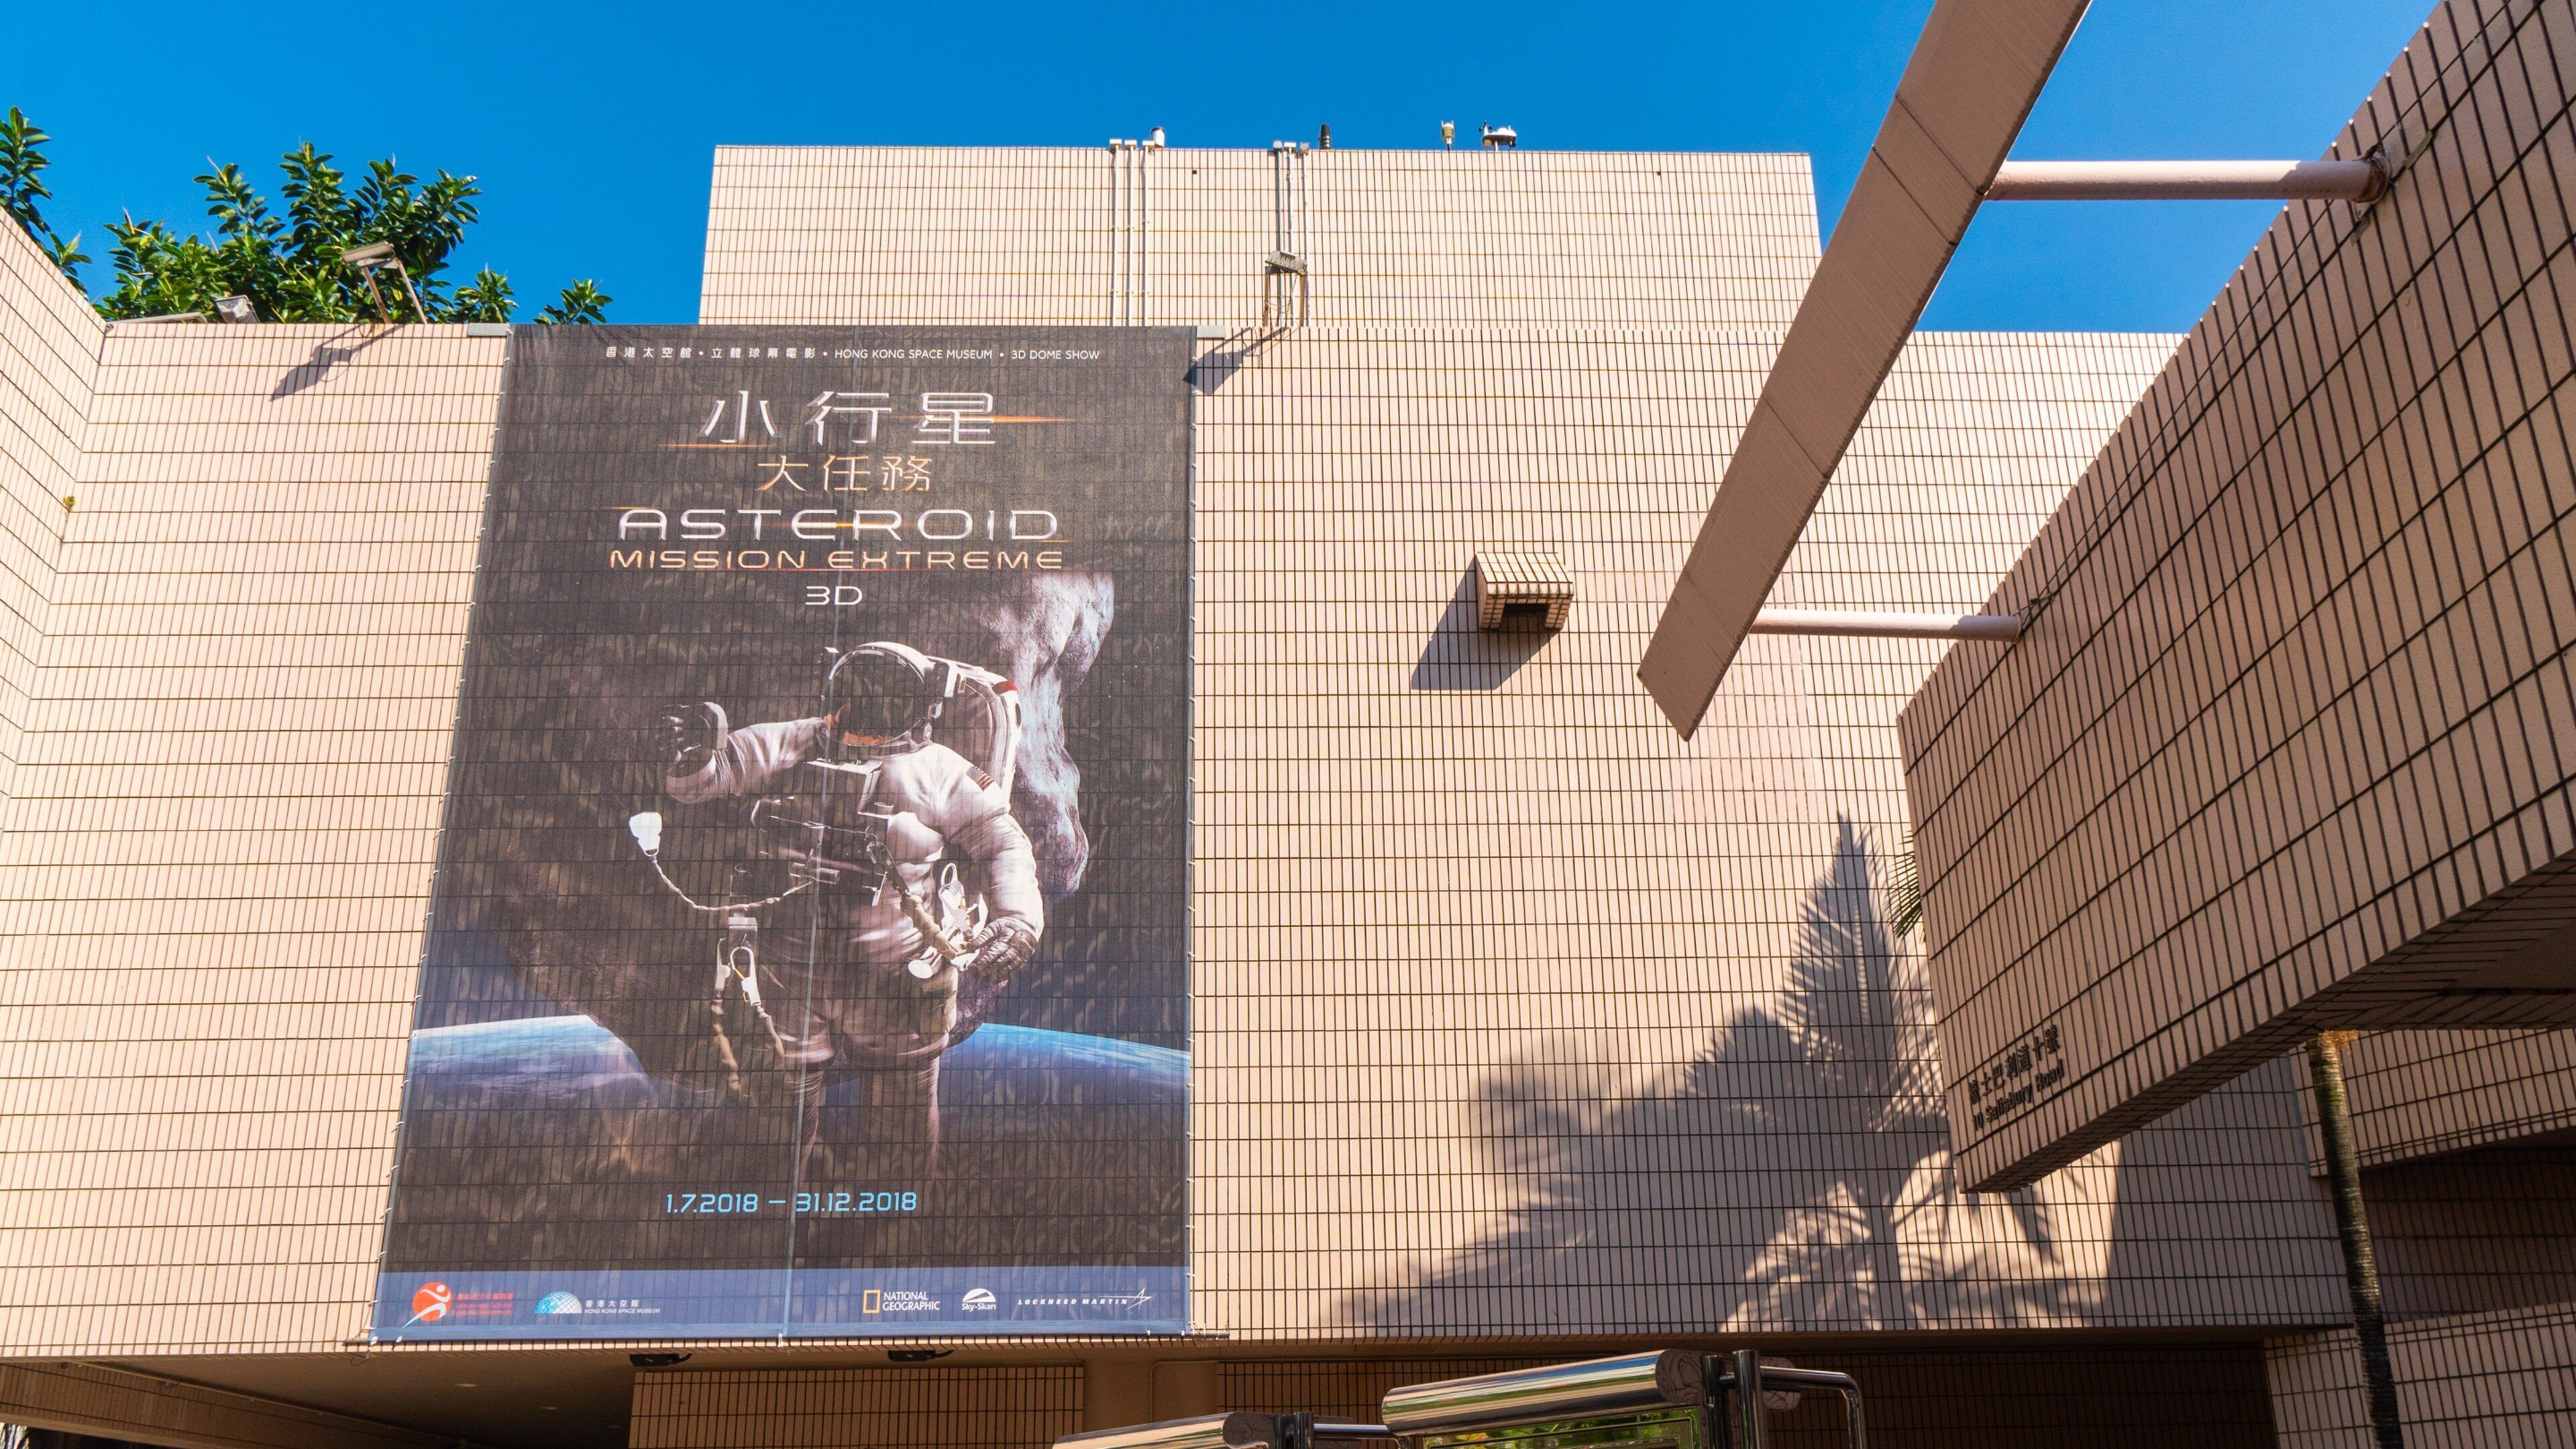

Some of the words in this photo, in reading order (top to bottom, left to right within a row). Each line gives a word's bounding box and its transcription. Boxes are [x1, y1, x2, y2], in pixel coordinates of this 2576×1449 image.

[606, 347, 692, 358] 香港太空館
[835, 350, 868, 359] HONG
[872, 350, 905, 359] KONG
[908, 350, 943, 359] SPACE
[947, 350, 992, 359] MUSEUM
[1011, 350, 1026, 360] 3D
[1030, 350, 1061, 360] DOME
[1065, 350, 1100, 360] SHOW
[697, 390, 996, 445] 小行星
[757, 455, 932, 492] 大任務
[619, 508, 1058, 541] ASTEROID
[610, 550, 806, 570] MISSION
[827, 550, 1063, 570] EXTREME
[806, 586, 863, 605] 3D
[1973, 1111, 1984, 1131] 10
[2035, 1058, 2064, 1093] Road
[666, 1193, 759, 1213] 1.7.2018
[796, 1191, 916, 1212] 31.12.2018
[585, 1299, 639, 1307] 香港太空館
[883, 1291, 928, 1301] NATIONAL
[882, 1301, 941, 1311] GEOGRAPHIC
[961, 1302, 997, 1312] Sky-Skan
